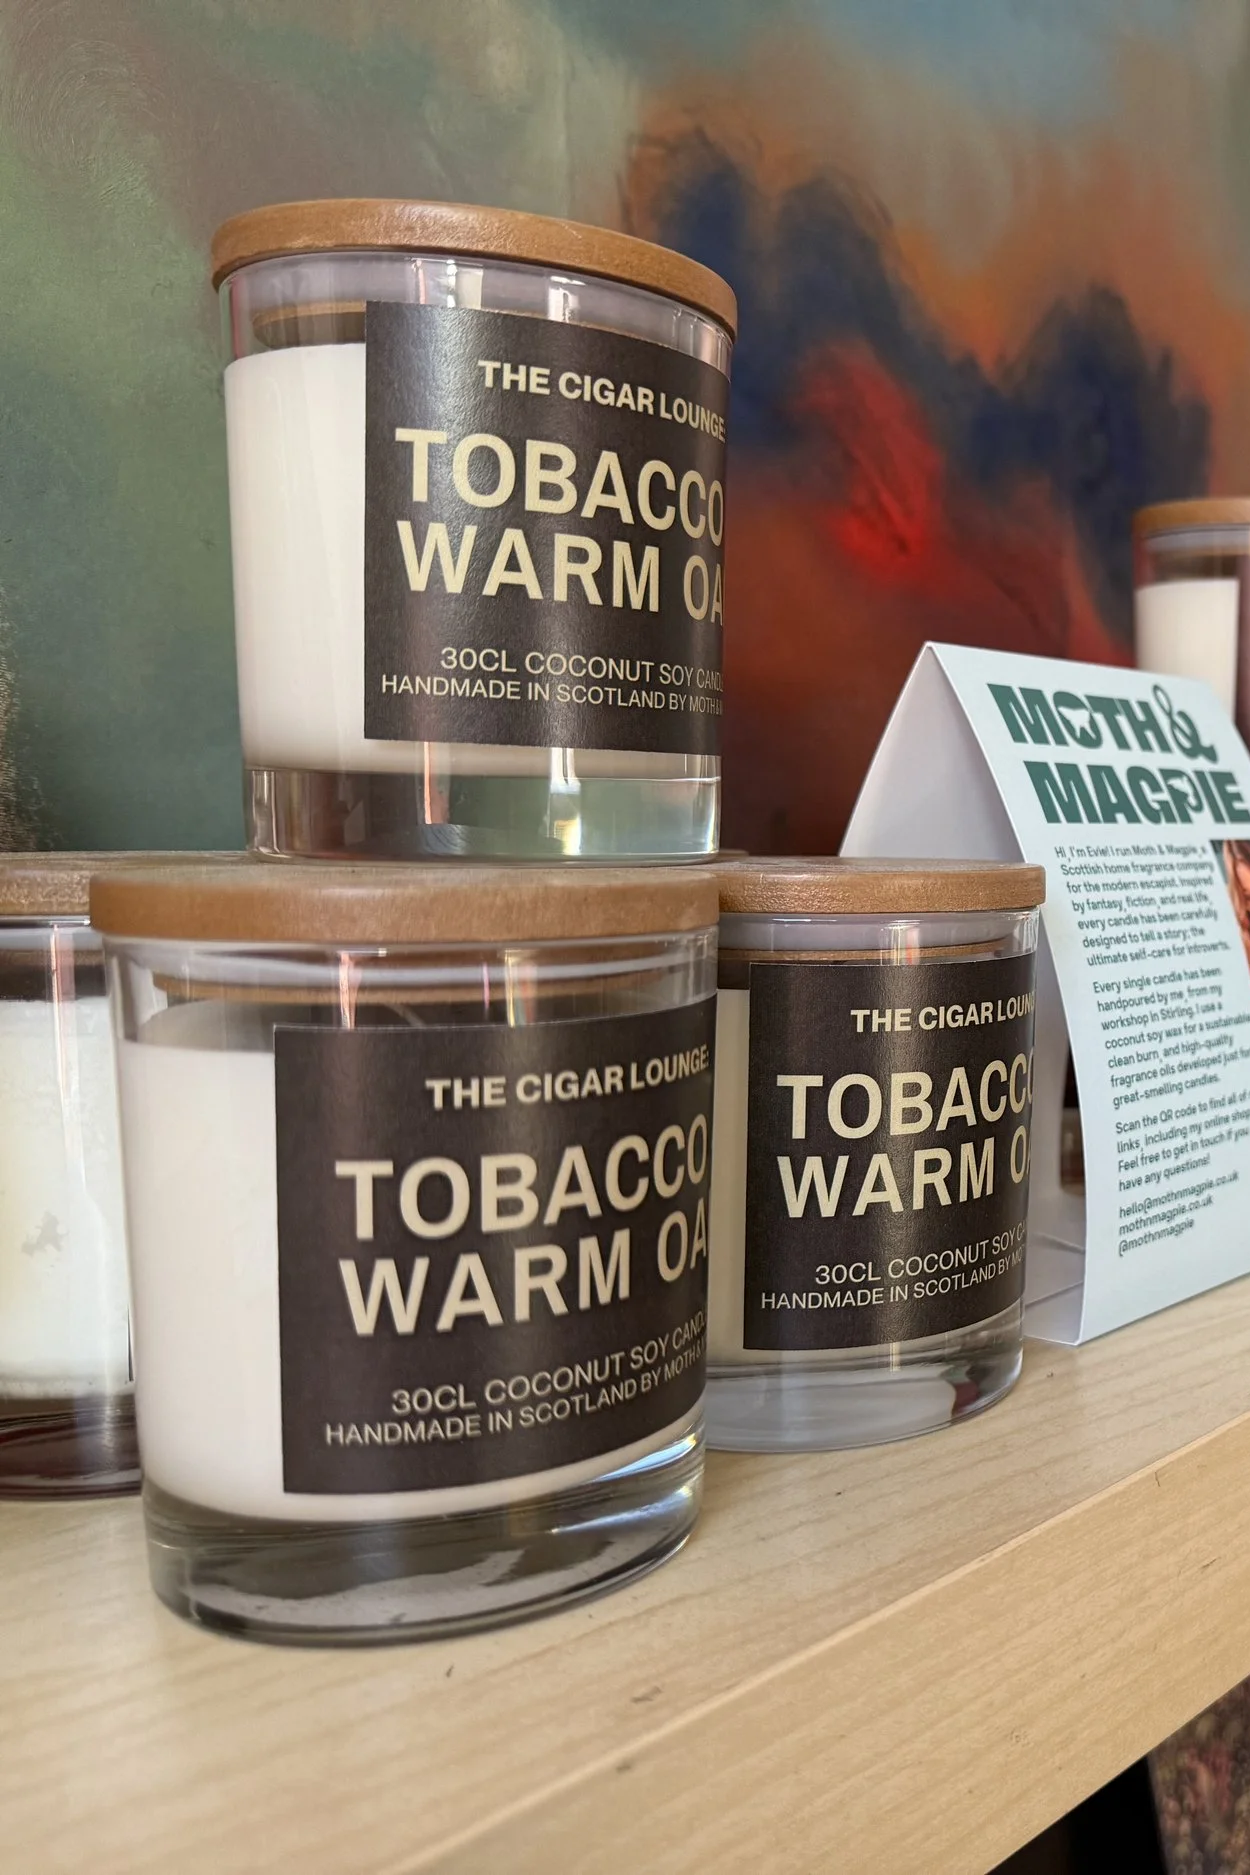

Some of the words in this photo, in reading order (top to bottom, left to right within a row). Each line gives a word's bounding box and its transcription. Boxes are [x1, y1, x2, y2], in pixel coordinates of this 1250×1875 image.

[478, 359, 550, 395] THE
[558, 371, 654, 416] CIGAR
[395, 427, 724, 547] TOBACCO
[396, 520, 660, 613] WARM
[440, 647, 517, 674] 30CL
[524, 651, 654, 683] COCONUT
[660, 663, 694, 686] SOY
[382, 674, 521, 701] HANDMADE
[527, 682, 549, 701] IN
[556, 683, 666, 710] SCOTLAND
[669, 692, 686, 710] BY
[689, 695, 716, 714] MOTH
[987, 683, 1174, 751] MOTH
[1151, 684, 1219, 764] &
[1055, 846, 1071, 862] Hi,
[1070, 847, 1087, 858] I'm
[1087, 846, 1109, 857] Evie!
[1116, 848, 1129, 857] run
[1131, 846, 1155, 856] Moth
[1157, 845, 1165, 855] &
[1166, 845, 1201, 858] Magpie,
[1061, 863, 1104, 876] Scottish
[1104, 862, 1130, 874] home
[1131, 862, 1175, 875] fragrance
[1176, 860, 1215, 872] company
[1067, 882, 1082, 893] for
[1084, 881, 1100, 892] the
[1102, 880, 1139, 892] modern
[1180, 876, 1213, 888] Inspired
[1072, 901, 1085, 914] by
[1087, 899, 1127, 912] fantasy,
[1126, 896, 1160, 909] fiction,
[1160, 894, 1176, 905] and
[1178, 893, 1194, 903] real
[1078, 919, 1106, 931] every
[1108, 914, 1140, 928] candle
[1141, 913, 1157, 924] has
[1158, 911, 1180, 922] been
[1181, 908, 1218, 921] carefully
[1082, 934, 1128, 949] designed
[1129, 933, 1139, 943] to
[1140, 930, 1156, 942] tell
[1157, 932, 1162, 940] a
[1189, 926, 1205, 936] the
[1087, 952, 1128, 966] ultimate
[1130, 948, 1171, 962] self-care
[1172, 944, 1185, 956] for
[1187, 940, 1231, 953] introverts.
[1093, 980, 1121, 994] Every
[1123, 976, 1151, 992] single
[1152, 972, 1182, 985] candle
[1183, 969, 1199, 980] has
[1200, 967, 1221, 978] been
[1097, 994, 1157, 1012] handpoured
[1157, 993, 1168, 1005] by
[1170, 991, 1188, 1003] me,
[1187, 986, 1208, 997] from
[1209, 984, 1223, 997] my
[851, 1007, 911, 1033] THE
[918, 1001, 993, 1029] CIGAR
[1101, 1014, 1149, 1031] workshop
[1151, 1011, 1160, 1022] in
[1160, 1006, 1195, 1020] Stirling.
[1200, 1003, 1215, 1013] use
[1217, 1002, 1222, 1010] a
[1105, 1033, 1145, 1049] coconut
[1147, 1031, 1163, 1043] soy
[1165, 1029, 1182, 1038] wax
[1184, 1023, 1197, 1033] for
[1199, 1022, 1204, 1031] a
[1108, 1055, 1135, 1068] clean
[1136, 1050, 1163, 1063] burn,
[1163, 1045, 1179, 1056] and
[1181, 1034, 1234, 1055] high-quality
[1110, 1070, 1158, 1088] fragrance
[1160, 1065, 1175, 1077] oils
[1177, 1055, 1221, 1072] developed
[1222, 1051, 1239, 1065] just
[425, 1076, 506, 1111] THE
[516, 1064, 625, 1104] CIGAR
[1113, 1082, 1184, 1110] great-smelling
[1185, 1073, 1221, 1089] candles.
[1115, 1120, 1141, 1134] Scan
[1142, 1116, 1158, 1128] the
[1159, 1110, 1174, 1122] QR
[1175, 1105, 1197, 1119] code
[1198, 1102, 1208, 1112] to
[1209, 1096, 1225, 1109] find
[1227, 1093, 1236, 1104] all
[1238, 1092, 1248, 1101] of
[1117, 1139, 1144, 1153] links,
[1145, 1125, 1187, 1146] including
[1189, 1123, 1202, 1134] my
[1204, 1115, 1230, 1128] online
[1118, 1156, 1139, 1172] Feel
[1140, 1150, 1160, 1165] free
[1162, 1149, 1172, 1159] to
[1173, 1143, 1189, 1159] get
[1191, 1140, 1199, 1151] in
[1200, 1131, 1225, 1148] touch
[1226, 1128, 1233, 1139] if
[1234, 1128, 1249, 1142] you
[334, 1113, 708, 1241] TOBACCO
[776, 1136, 995, 1218] WARM
[1119, 1176, 1142, 1191] have
[1145, 1170, 1162, 1184] any
[1164, 1153, 1211, 1179] questions!
[1119, 1170, 1239, 1218] hello@mothnmagpie.co.uk
[1119, 1194, 1213, 1236] mothnmagpie.co.uk
[815, 1262, 881, 1285] 30CL
[888, 1240, 989, 1280] COCONUT
[992, 1227, 1016, 1254] SOY
[1118, 1218, 1195, 1257] @mothnmagpie
[338, 1227, 632, 1337] WARM
[761, 1287, 883, 1309] HANDMADE
[889, 1285, 908, 1302] IN
[913, 1263, 996, 1299] SCOTLAND
[998, 1255, 1010, 1274] BY
[391, 1384, 477, 1418] 30CL
[485, 1351, 626, 1406] COCONUT
[630, 1333, 670, 1369] SOY
[672, 1310, 705, 1350] CAND
[326, 1415, 481, 1447] HANDMADE
[488, 1412, 514, 1435] IN
[519, 1379, 637, 1430] SCOTLAND
[640, 1367, 662, 1393] BY
[664, 1345, 696, 1382] MOTH
